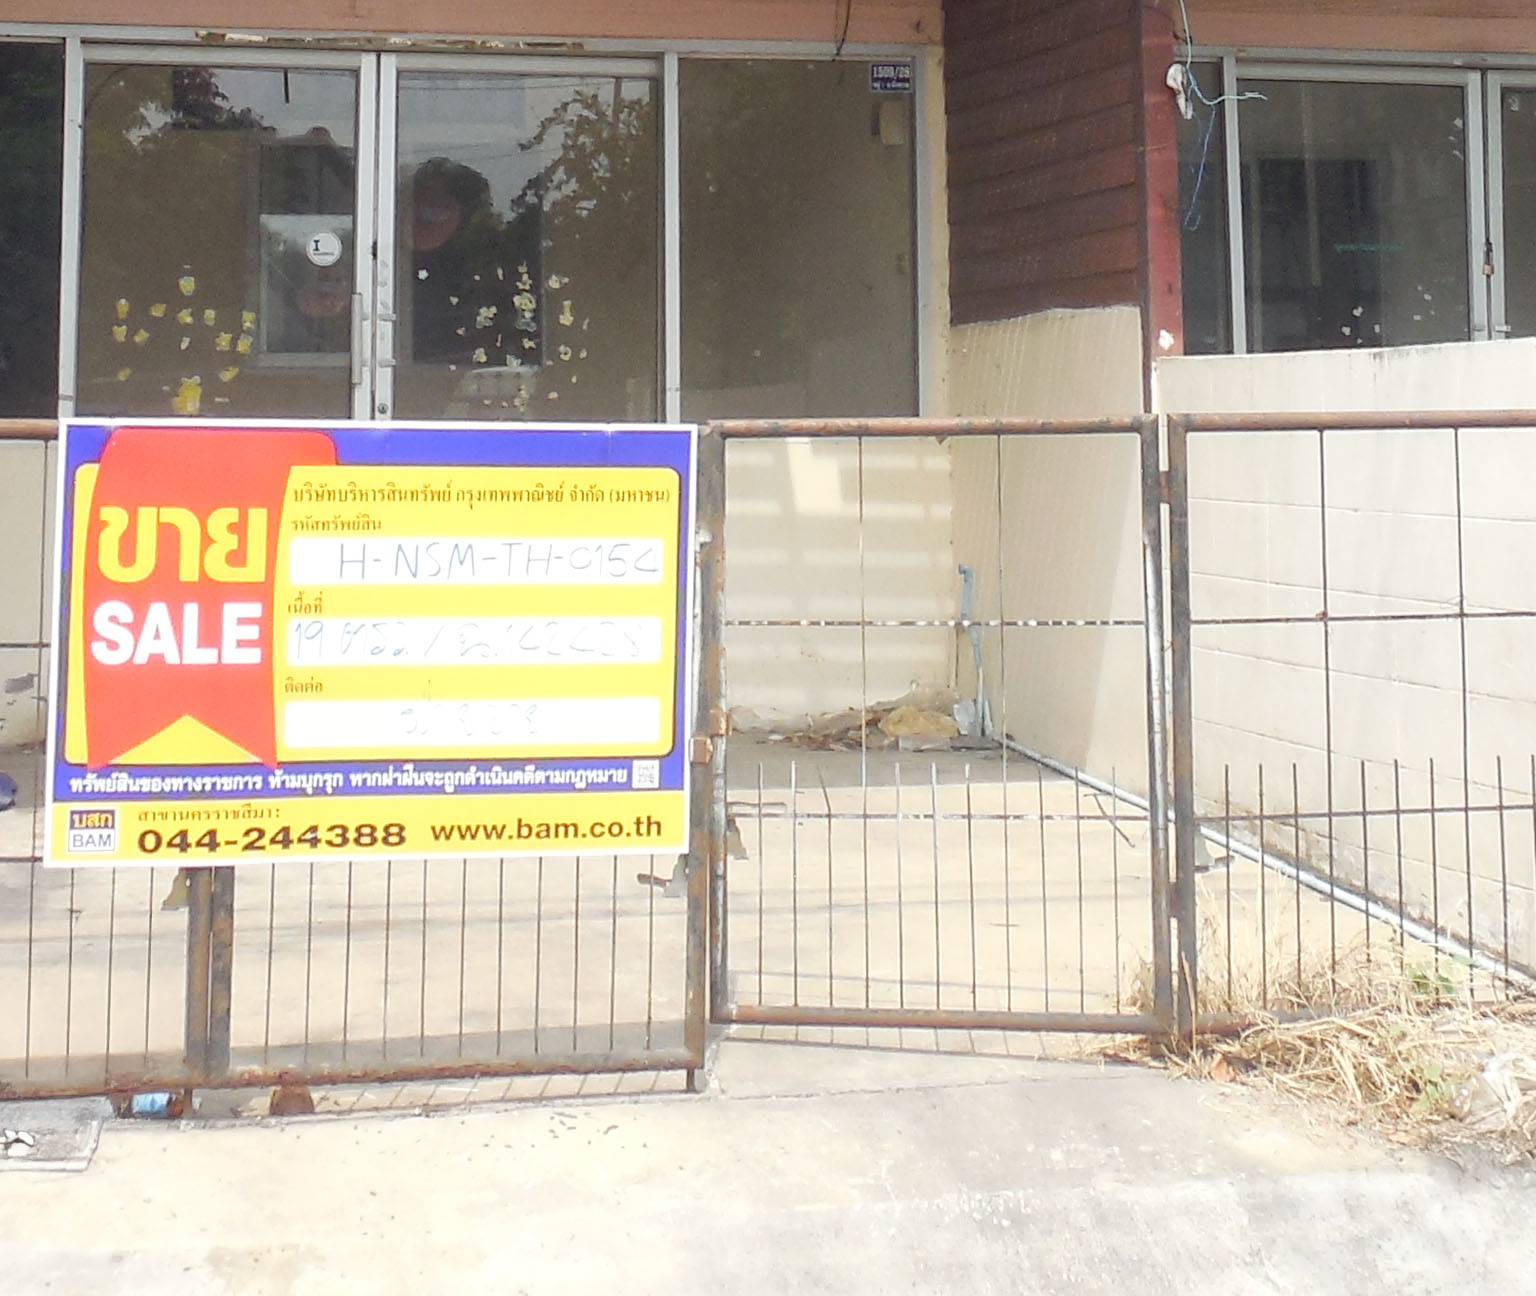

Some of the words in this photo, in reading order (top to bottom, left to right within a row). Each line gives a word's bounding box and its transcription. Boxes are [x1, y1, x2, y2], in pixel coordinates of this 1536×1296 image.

[293, 480, 453, 502] บริษัทบริหารสินทรัพย์
[456, 480, 565, 510] กรุงเทพพาณิชย์
[569, 483, 605, 502] จำกัด
[608, 487, 670, 503] (มหาชน)
[291, 513, 382, 531] รหัสทรัพย์สิน
[97, 506, 268, 584] ขาย
[288, 590, 324, 614] เนื้อที่
[90, 601, 263, 666] SALE
[284, 676, 324, 695] ติดต่อ
[69, 770, 263, 793] ทรัพย์สินของทางราชการ
[267, 769, 344, 795] ห้ามบุกรุก
[72, 811, 113, 828] บสก
[71, 833, 113, 848] BAM
[137, 823, 407, 854] 044-244388
[430, 815, 663, 841] www.bam.co.th
